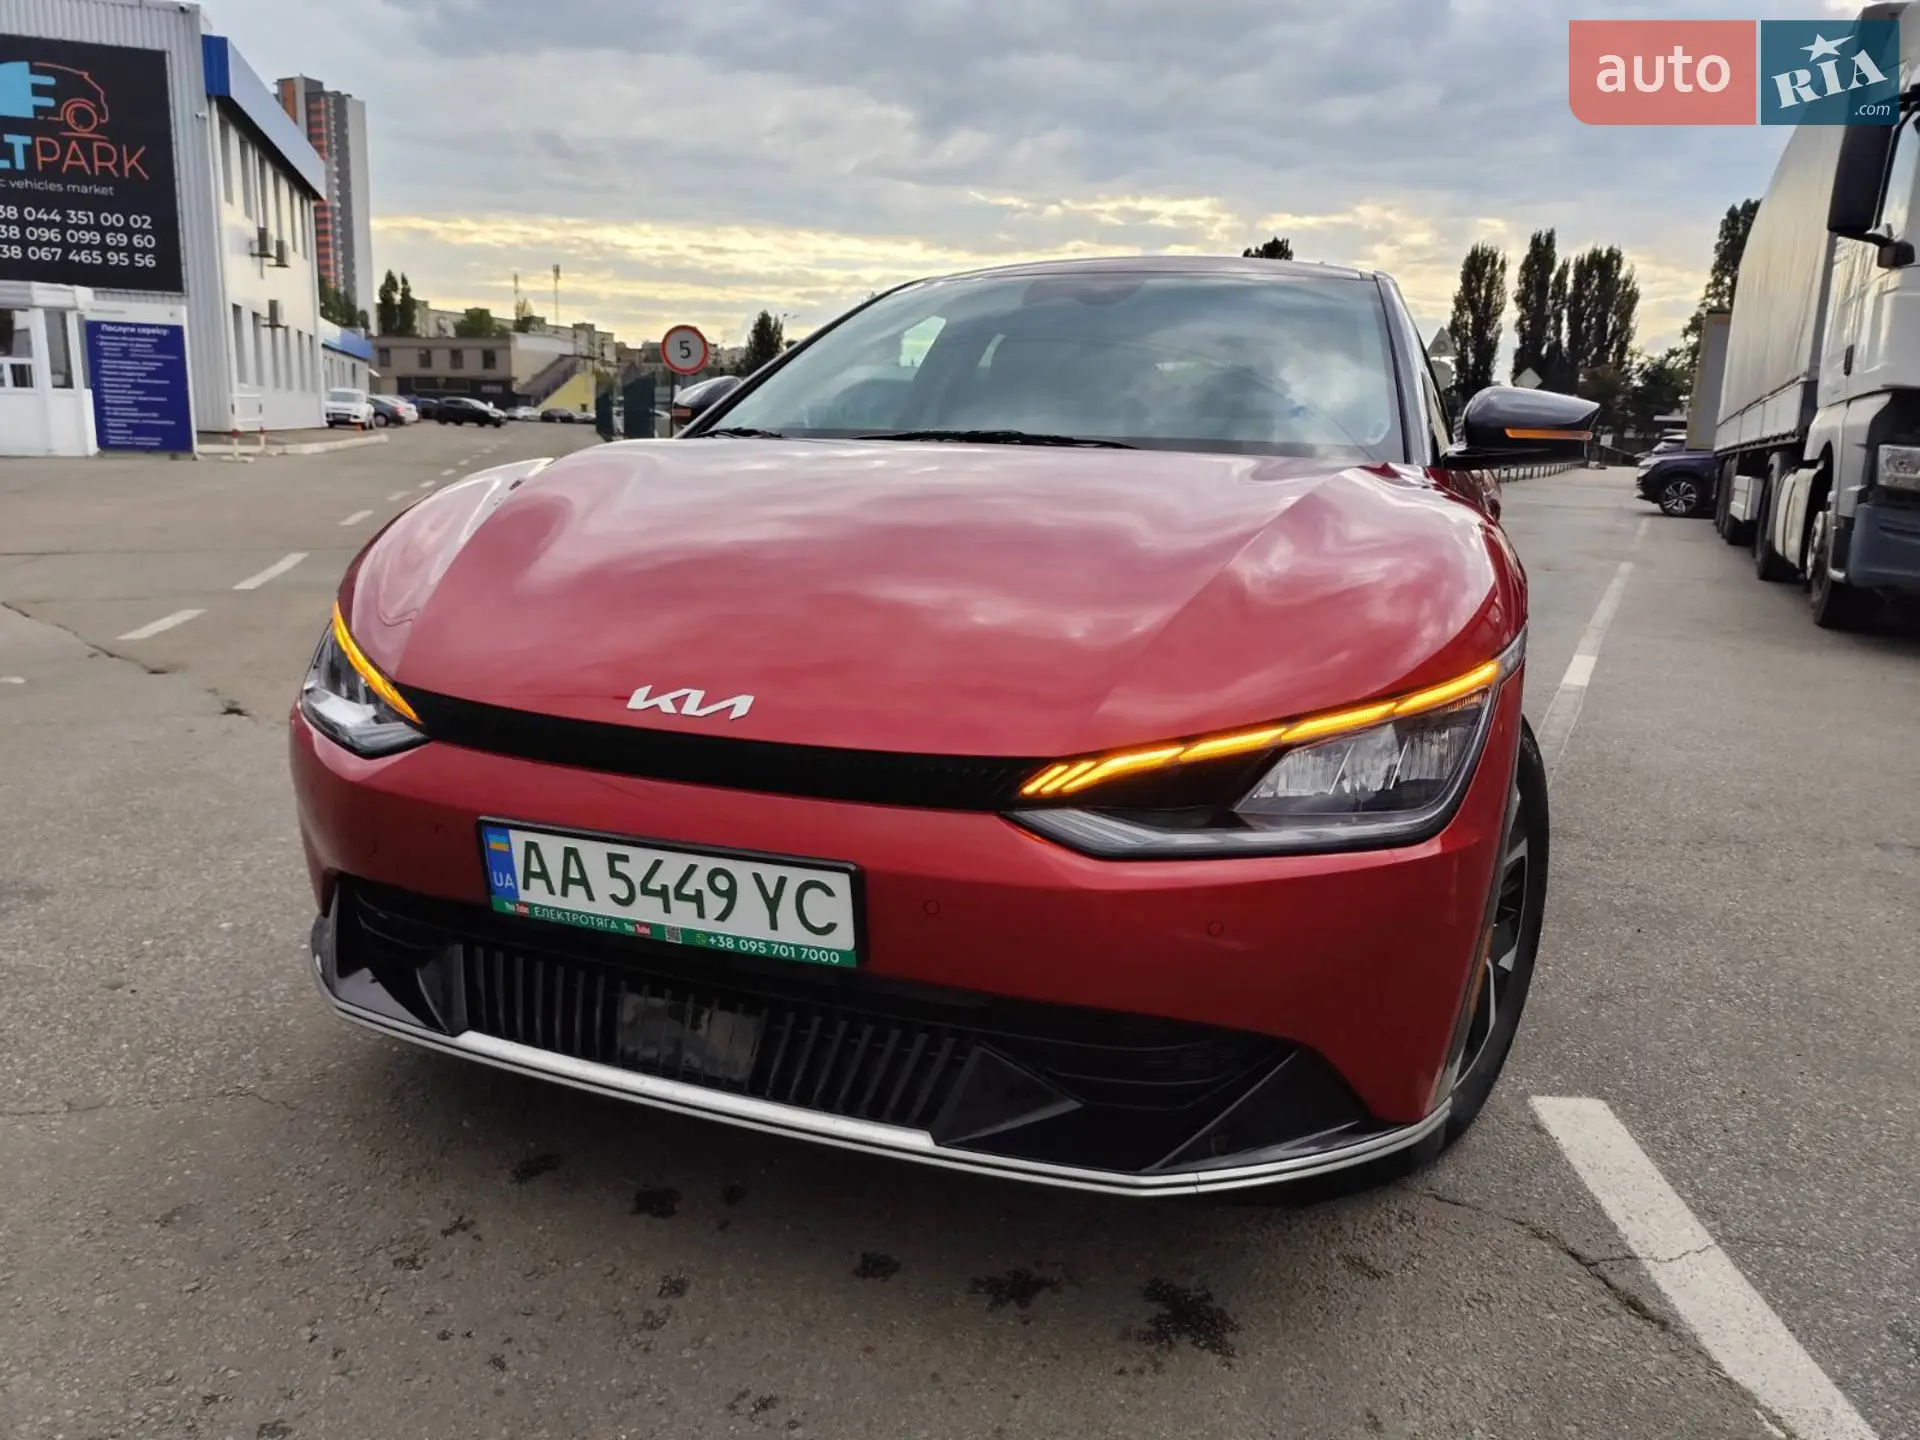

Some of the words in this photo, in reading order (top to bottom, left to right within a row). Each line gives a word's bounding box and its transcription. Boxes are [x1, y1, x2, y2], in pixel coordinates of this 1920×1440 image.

[9, 178, 64, 192] vehicles
[66, 183, 115, 197] market
[23, 207, 62, 223] 044
[66, 209, 95, 225] 351
[100, 212, 125, 227] 00
[129, 214, 153, 229] 02
[25, 227, 62, 242] 096
[66, 229, 101, 245] 099
[105, 232, 128, 247] 69
[132, 234, 156, 249] 60
[0, 244, 22, 259] 38
[28, 246, 62, 261] 067
[68, 250, 103, 264] 465
[106, 251, 129, 266] 95
[134, 254, 156, 268] 56
[679, 339, 692, 359] 5
[626, 684, 755, 720] KIA
[493, 871, 515, 890] UA
[522, 840, 596, 902] AA
[606, 852, 738, 922] 5449
[752, 871, 838, 936] YC
[534, 906, 618, 930] ЕЛЕКТРОТЯГА
[708, 935, 735, 949] +38
[739, 939, 767, 954] 095
[771, 943, 796, 958] 701
[801, 947, 840, 964] 7000
